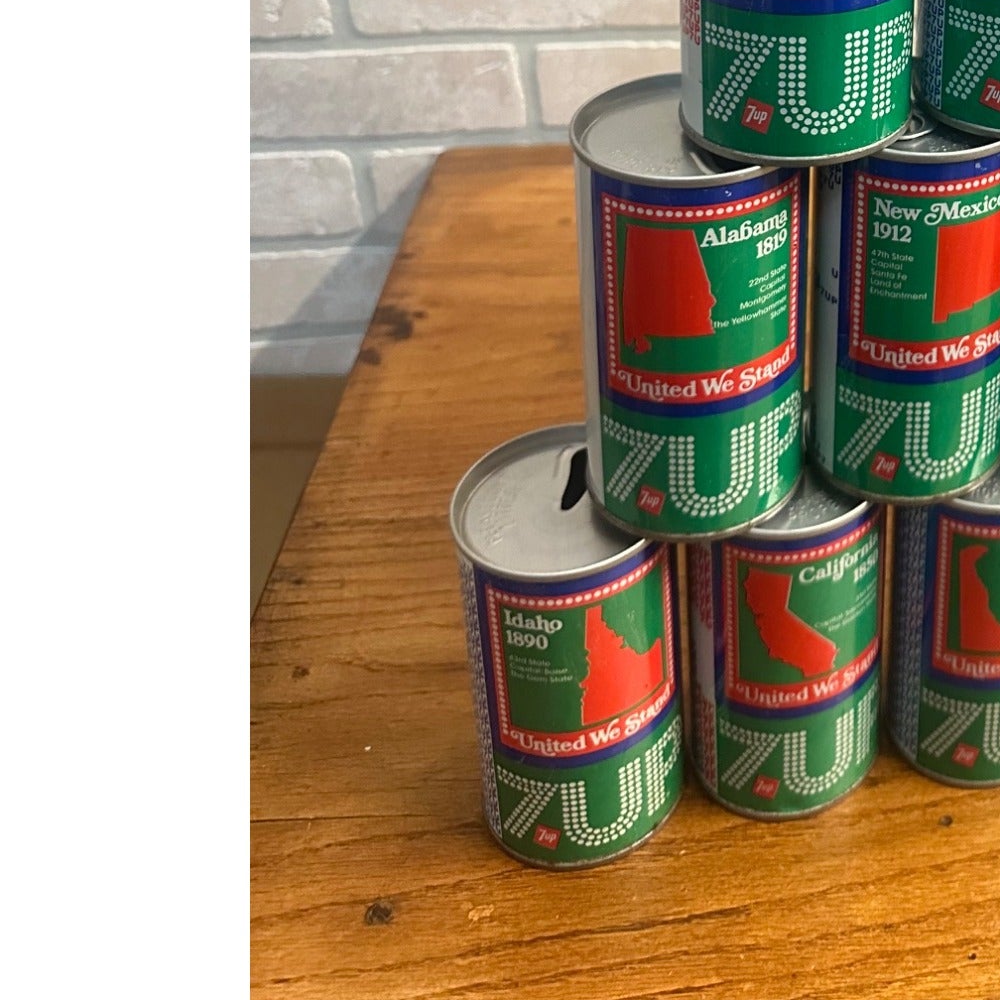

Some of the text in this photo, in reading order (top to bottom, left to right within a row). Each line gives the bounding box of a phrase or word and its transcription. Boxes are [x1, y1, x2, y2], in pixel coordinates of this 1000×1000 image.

[705, 11, 913, 136] 7UP
[745, 105, 768, 123] 7up
[873, 197, 922, 221] New
[700, 209, 788, 248] Alabama
[872, 221, 913, 244] 1912
[756, 229, 788, 259] 1819
[892, 253, 915, 263] State
[749, 263, 788, 288] 22nd State
[870, 268, 908, 282] Santa Fe
[870, 278, 902, 290] Land of
[740, 284, 787, 311] Montgomery
[869, 288, 928, 302] Enchantment
[713, 296, 787, 329] The Yellowhammer
[770, 306, 788, 320] State
[861, 339, 938, 369] United
[942, 336, 970, 362] We
[618, 349, 791, 401] United We Stand
[603, 389, 801, 517] 7UP
[504, 609, 563, 635] Idaho
[506, 629, 549, 650] 1890
[736, 671, 839, 708] United We
[510, 684, 671, 757] United We Stand
[496, 714, 682, 847] 7UP
